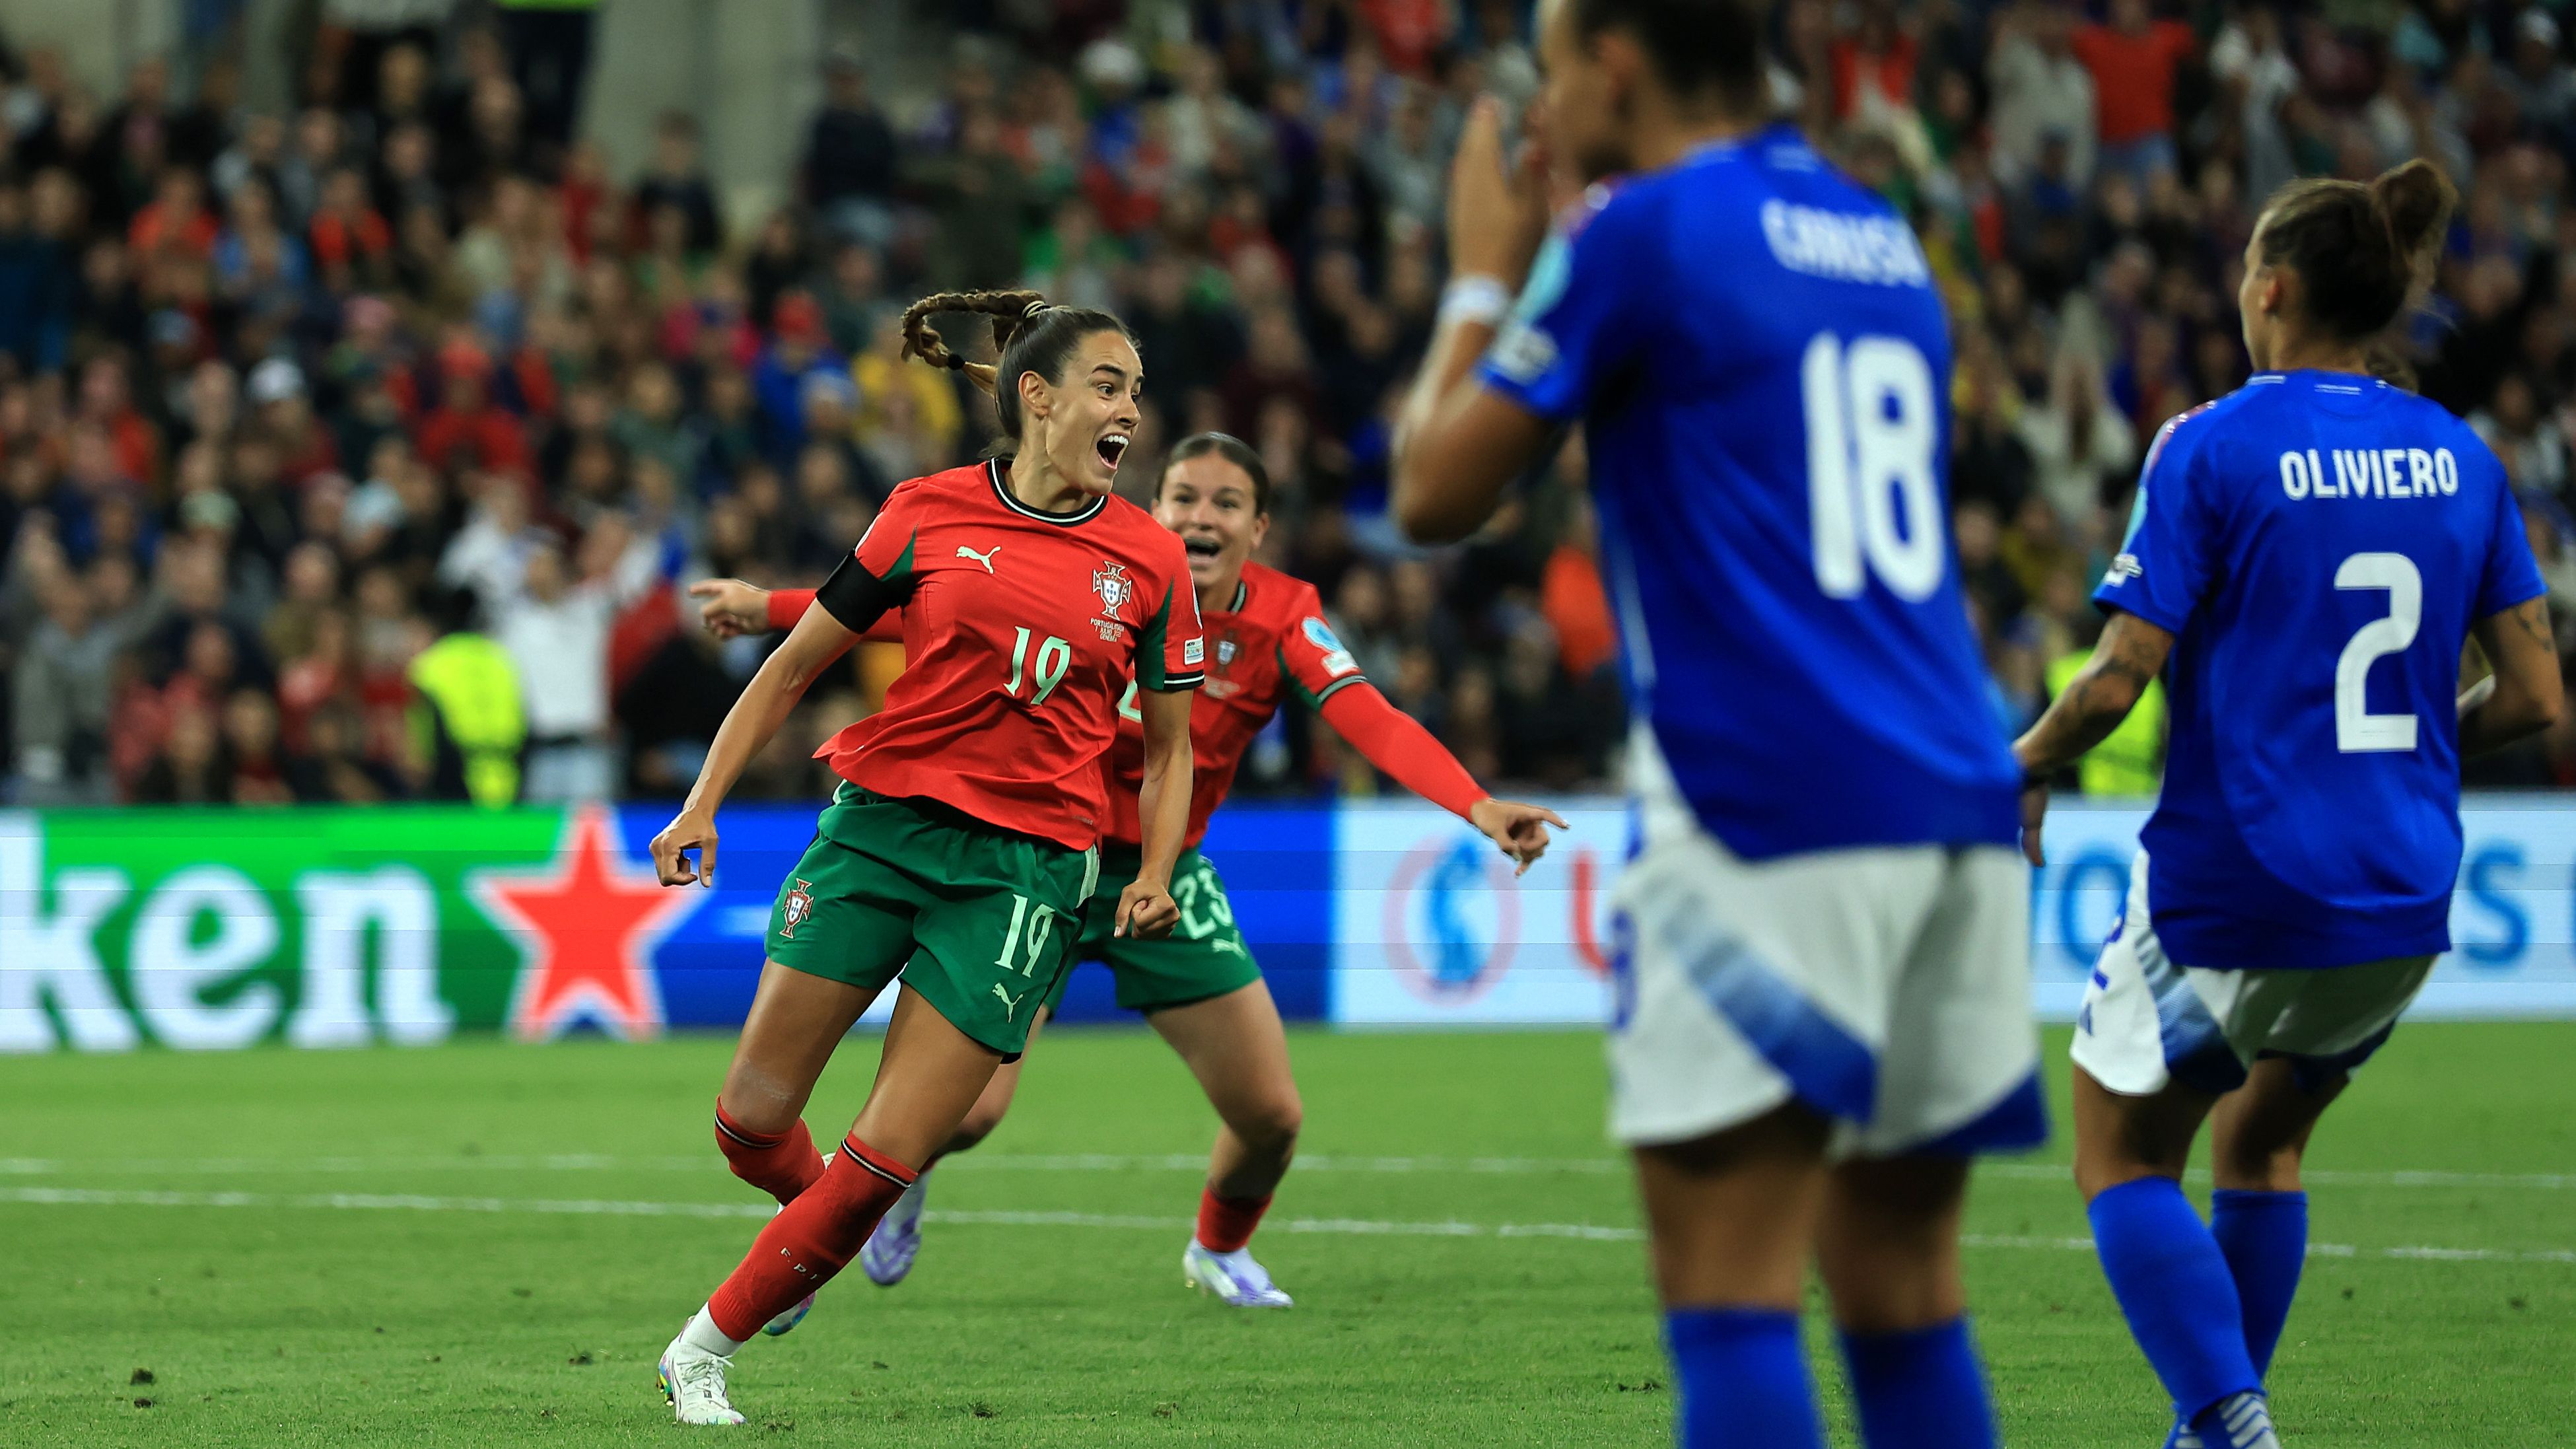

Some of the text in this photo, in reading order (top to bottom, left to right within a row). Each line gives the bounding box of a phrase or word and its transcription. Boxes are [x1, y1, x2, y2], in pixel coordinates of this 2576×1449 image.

[1801, 331, 1945, 604] 18
[2278, 446, 2459, 501] OLIVIERO
[1002, 625, 1072, 706] 19
[2333, 551, 2422, 754] 2
[0, 811, 456, 1051] ken
[994, 894, 1056, 978] 19
[1173, 867, 1235, 940] 23
